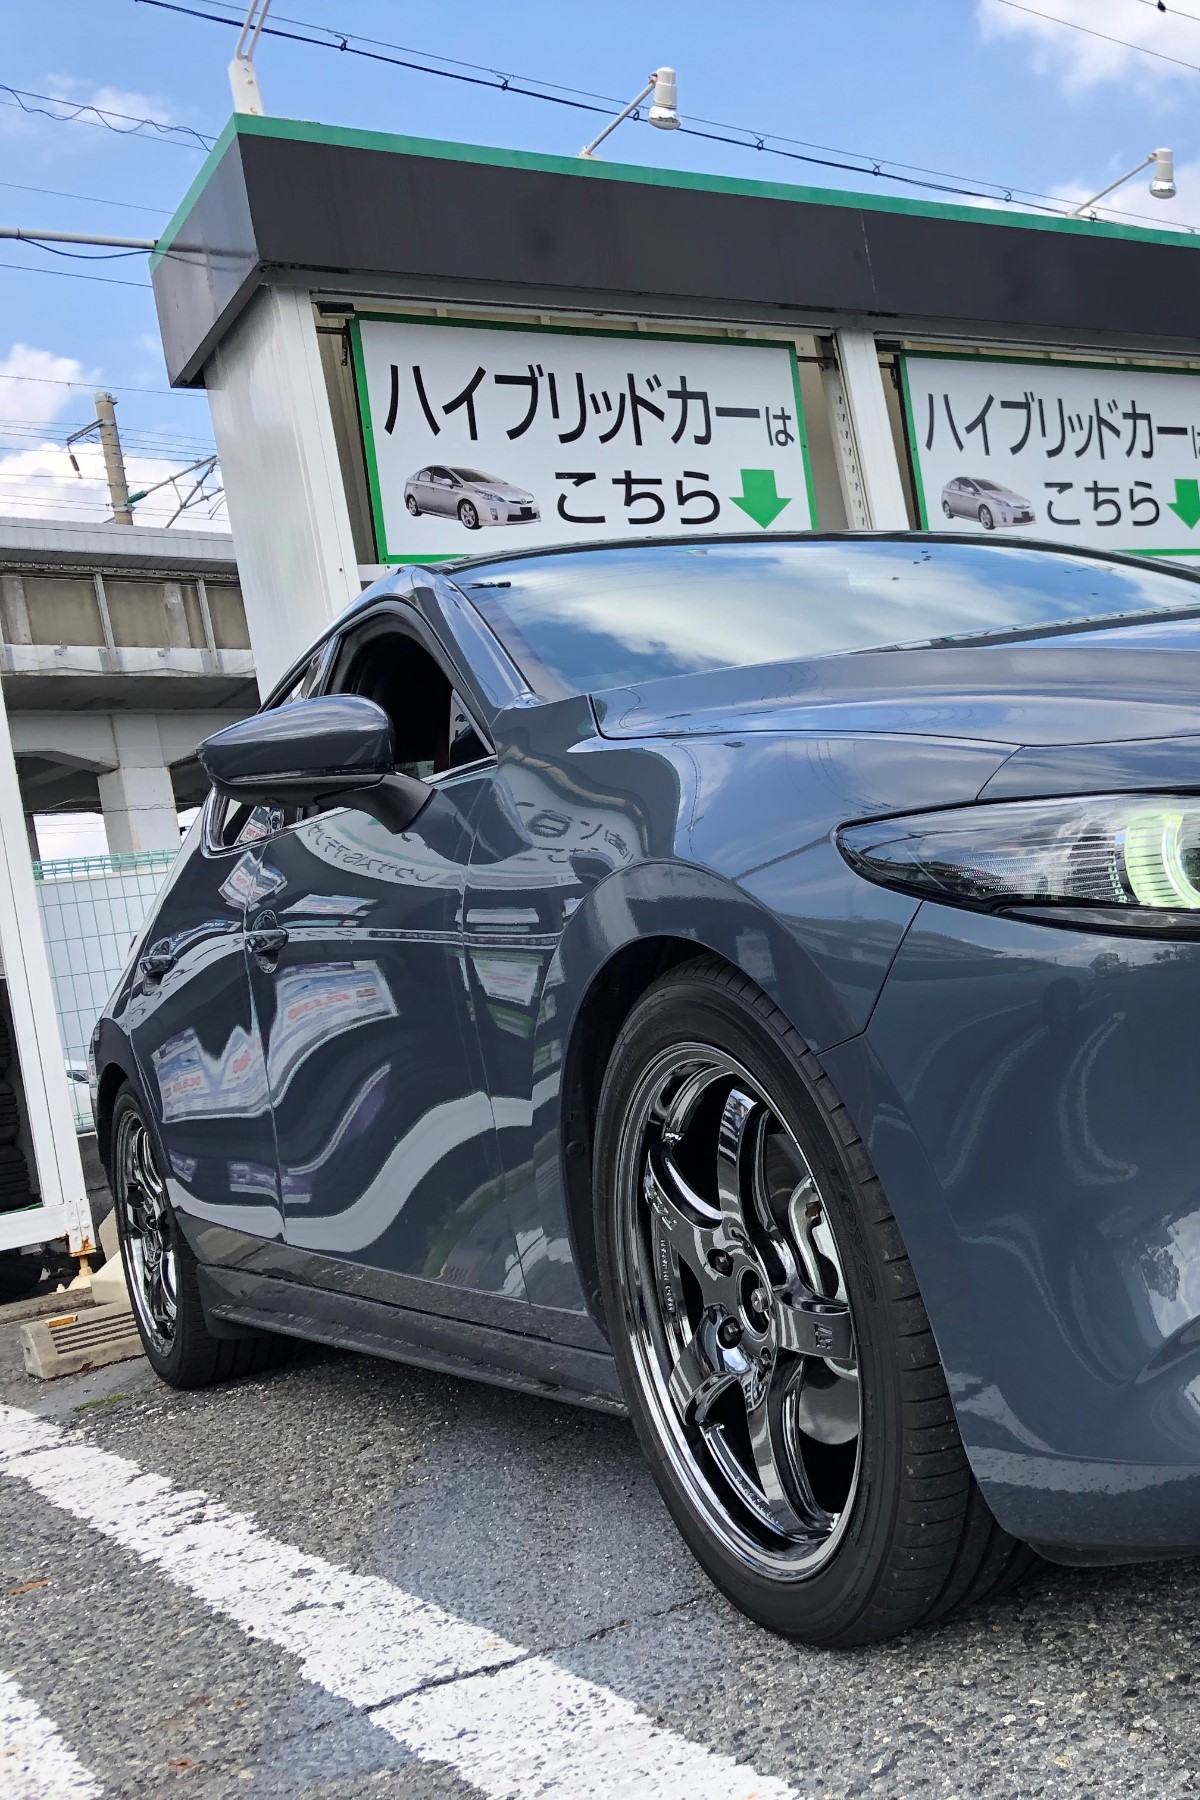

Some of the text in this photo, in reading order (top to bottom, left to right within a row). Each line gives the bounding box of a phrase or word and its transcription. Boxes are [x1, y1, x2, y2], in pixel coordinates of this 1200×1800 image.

[384, 363, 795, 447] ハイブリッドカーは
[554, 469, 721, 526] こちら
[1044, 480, 1161, 527] こちら
